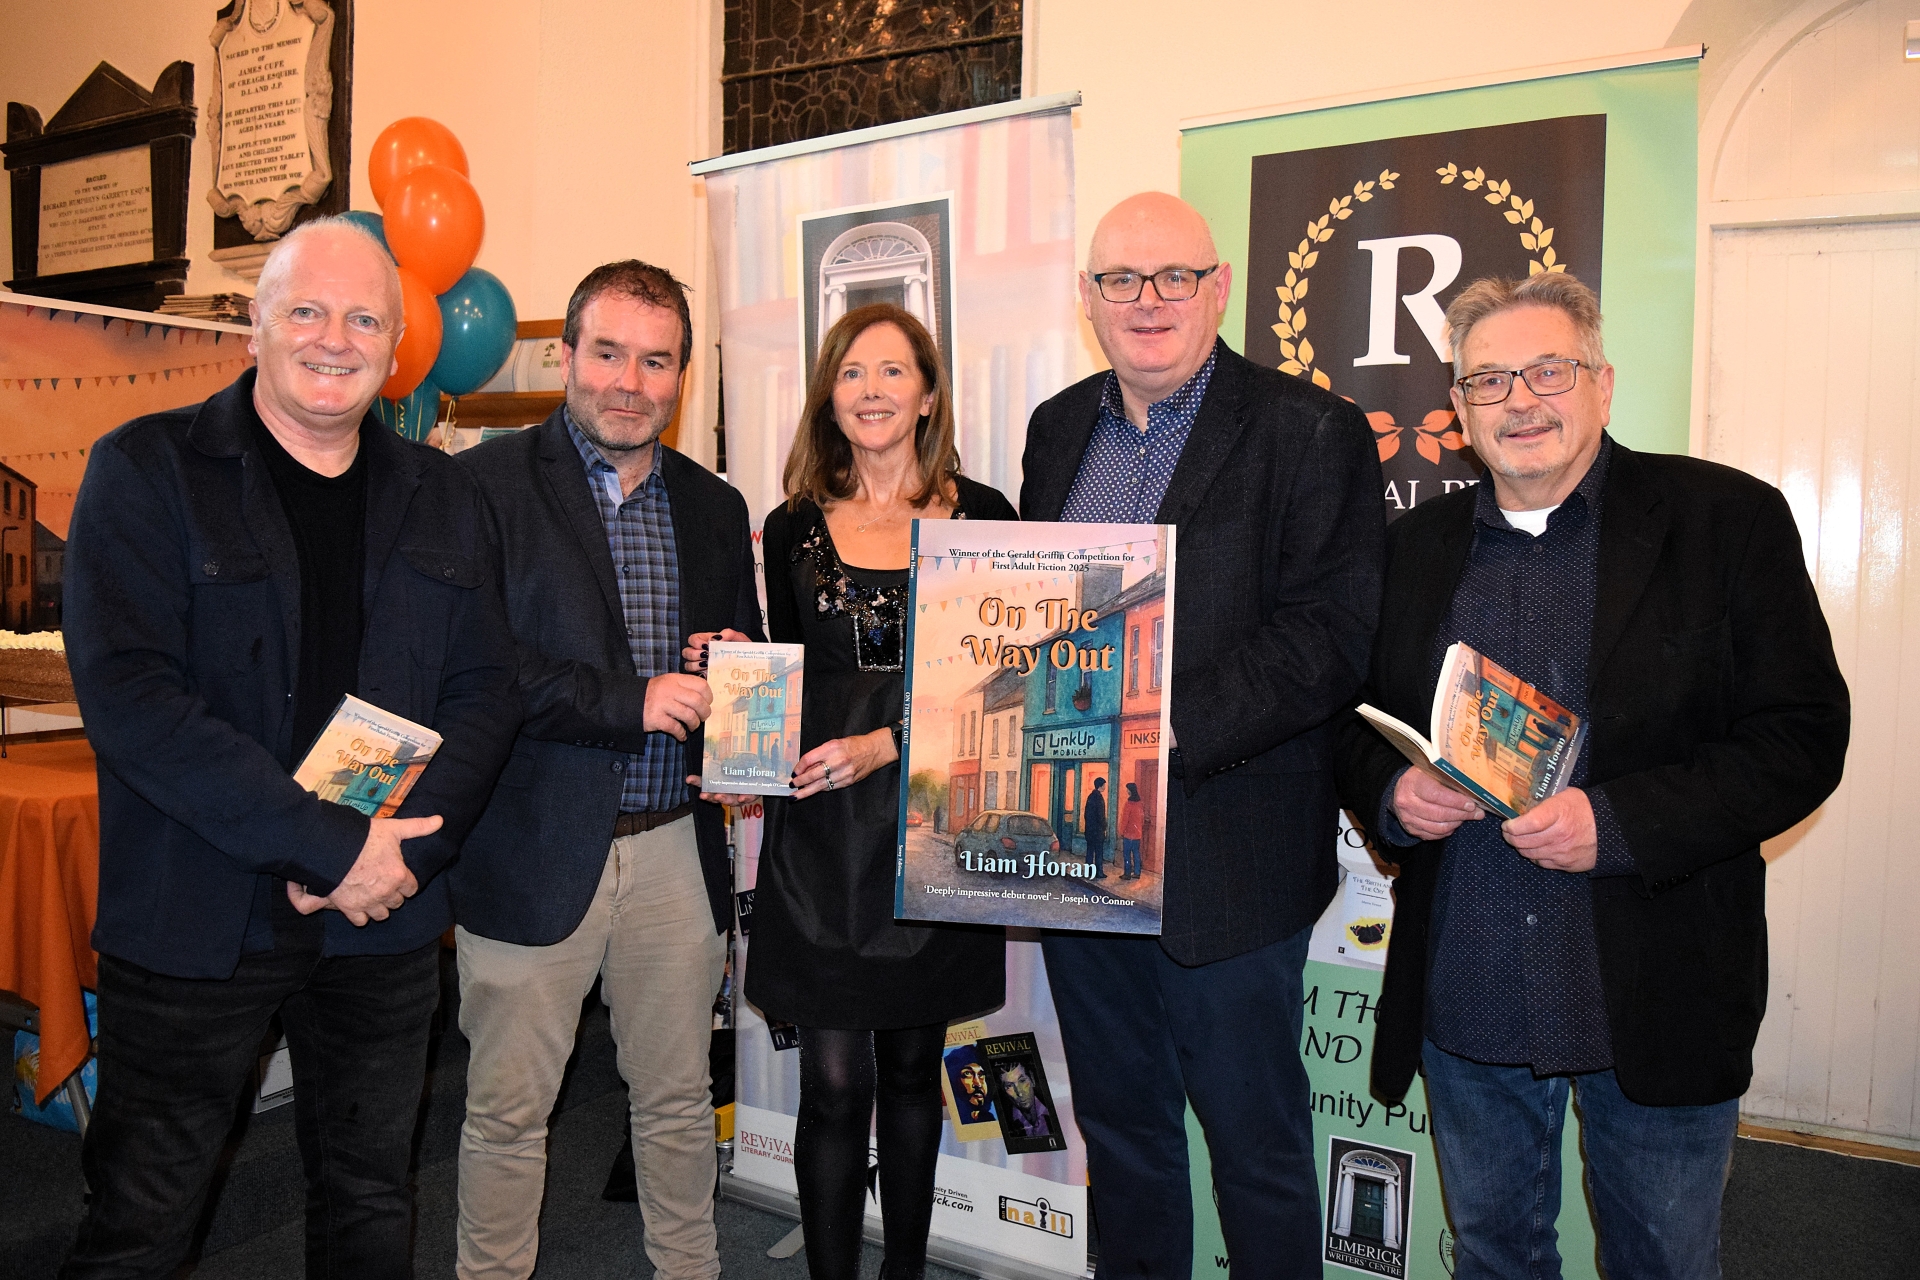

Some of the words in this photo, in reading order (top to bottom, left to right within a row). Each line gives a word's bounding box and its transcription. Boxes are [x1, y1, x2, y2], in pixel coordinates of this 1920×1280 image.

[226, 50, 249, 60] SACRED
[251, 46, 260, 54] TO
[262, 44, 274, 52] THE
[276, 37, 302, 48] MEMORY
[238, 65, 262, 76] JAMES
[254, 85, 268, 93] AND
[234, 104, 266, 116] DEPARTED
[258, 110, 285, 120] JANUARY
[239, 126, 254, 134] AGED
[273, 133, 297, 143] WIDOW
[253, 145, 284, 156] CHILDREN
[280, 152, 305, 160] TABLET
[244, 165, 278, 176] TESTIMONY
[269, 174, 287, 182] THEIR
[1353, 233, 1463, 368] R
[949, 548, 980, 558] Winner
[982, 549, 991, 558] of
[992, 550, 1006, 558] the
[1007, 550, 1035, 559] Gerald
[1037, 550, 1065, 560] Griffin
[1067, 552, 1121, 562] Competition
[1122, 553, 1135, 562] for
[992, 561, 1009, 570] First
[1011, 562, 1036, 571] Adult
[1037, 562, 1067, 572] Fiction
[1068, 564, 1089, 573] 2025
[978, 597, 1027, 631] On
[1035, 597, 1099, 633] The
[961, 635, 1040, 676] Way
[1050, 639, 1115, 672] Out
[731, 668, 750, 682] On
[753, 668, 778, 683] The
[724, 682, 755, 699] Way
[758, 685, 783, 698] Out
[905, 691, 911, 702] ON
[1466, 690, 1484, 718] The
[1470, 724, 1490, 762] Way
[1481, 688, 1499, 721] Out
[1049, 731, 1096, 751] LinkUp
[1461, 722, 1473, 747] On
[350, 738, 372, 756] On
[375, 747, 400, 768] The
[336, 749, 367, 775] Way
[369, 766, 397, 786] Out
[723, 766, 745, 776] Liam
[746, 766, 776, 777] Horan
[1535, 773, 1552, 799] Liam
[1547, 737, 1566, 773] Horan
[960, 850, 1018, 874] Liam
[1022, 850, 1097, 880] Horan
[957, 887, 1000, 899] impressive
[1001, 889, 1025, 900] debut
[1060, 894, 1088, 905] Joseph
[945, 1029, 981, 1044] EViVAL
[985, 1040, 1031, 1055] REViVAL
[741, 1130, 793, 1156] REViVA
[741, 1145, 771, 1158] LITERARY
[773, 1154, 794, 1164] JOURN
[948, 1188, 968, 1199] Driven
[1329, 1237, 1402, 1266] LIMERICK
[1369, 1261, 1402, 1276] CENTRE
